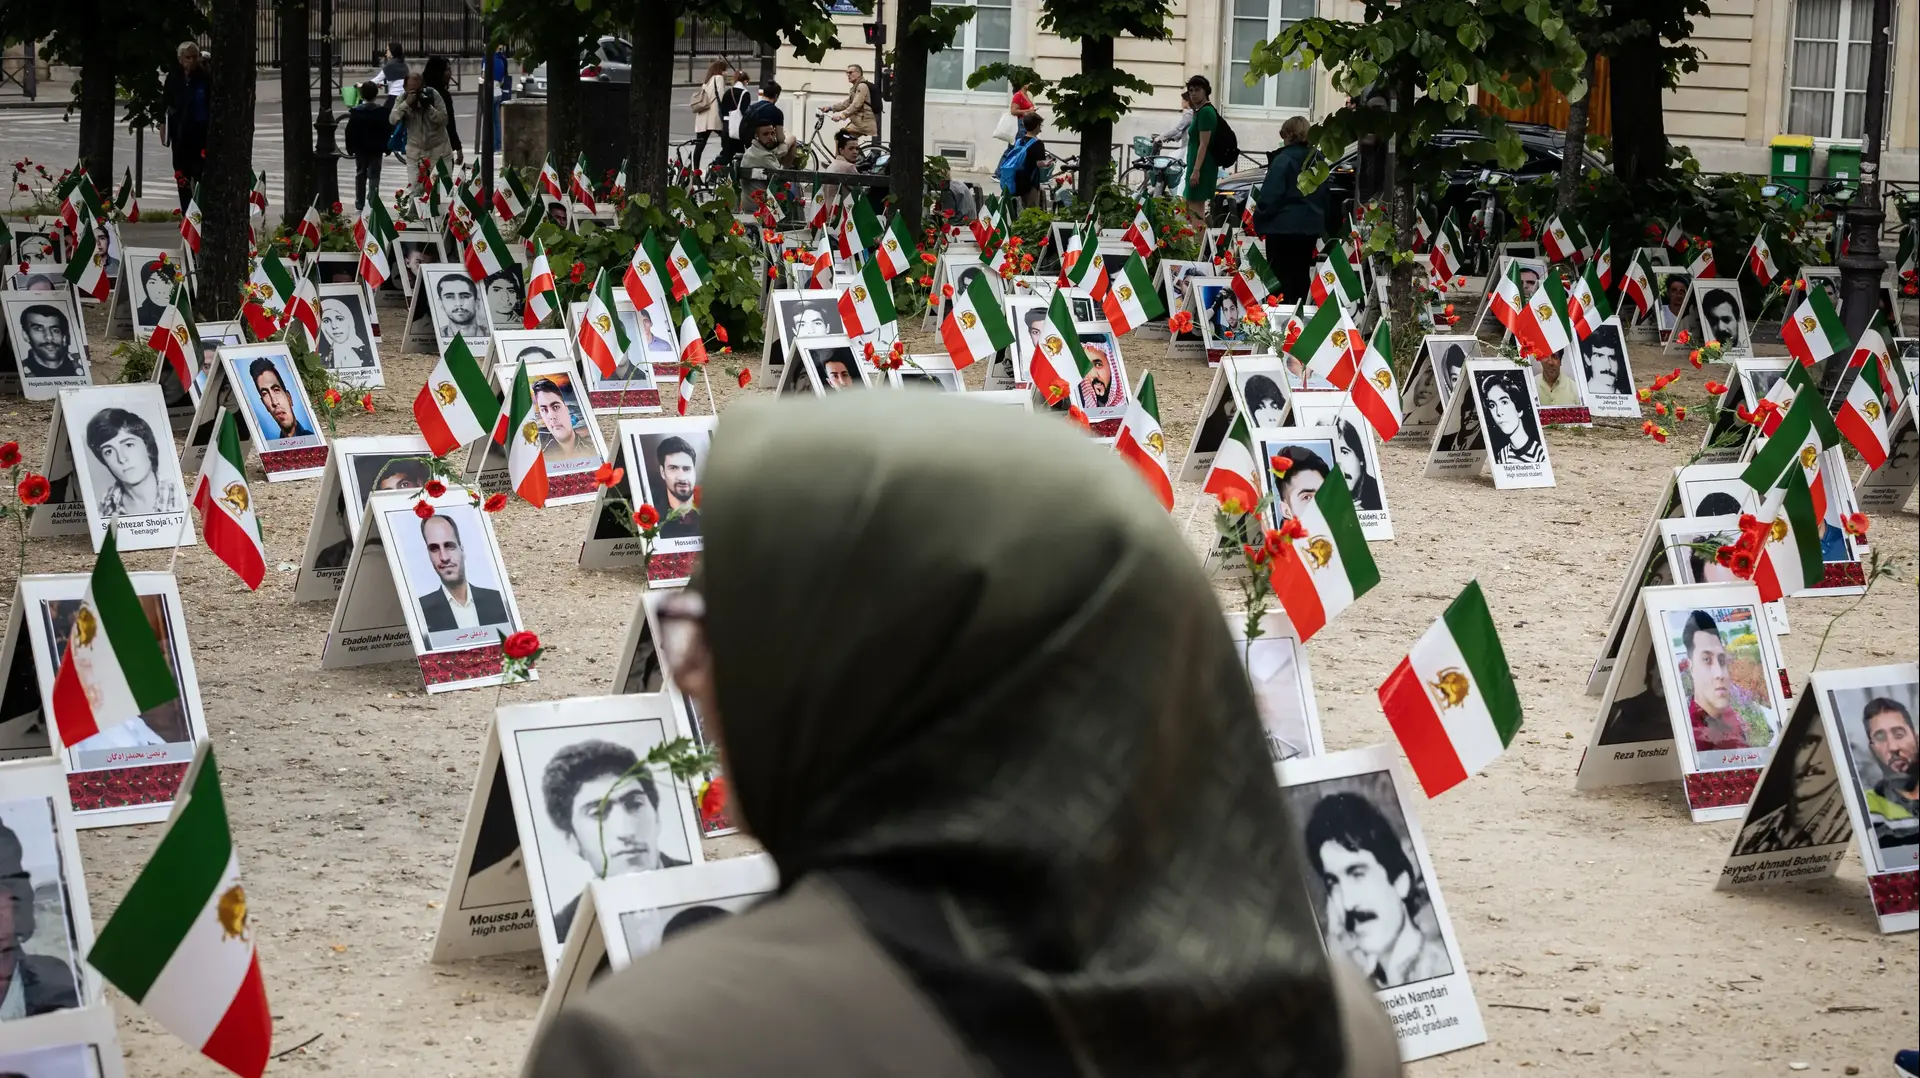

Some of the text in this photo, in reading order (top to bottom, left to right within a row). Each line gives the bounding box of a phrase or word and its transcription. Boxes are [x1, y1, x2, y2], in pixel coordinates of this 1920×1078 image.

[174, 516, 183, 524] 17
[130, 527, 160, 536] Teenager
[342, 632, 382, 646] Ebadollah
[348, 644, 370, 653] Nurse,
[370, 642, 393, 650] soccer
[1598, 665, 1614, 673] Jam
[1614, 747, 1669, 761] Reza Torshizi
[1756, 858, 1793, 871] Ahmad
[1793, 854, 1832, 867] Borhani,
[1731, 864, 1827, 885] Radio & TV Technician
[469, 911, 519, 926] Moussa
[471, 919, 535, 937] High school
[1408, 984, 1449, 1004] Namdari
[1390, 1003, 1437, 1026] asjedi, 31
[1396, 1015, 1459, 1040] chool graduate
